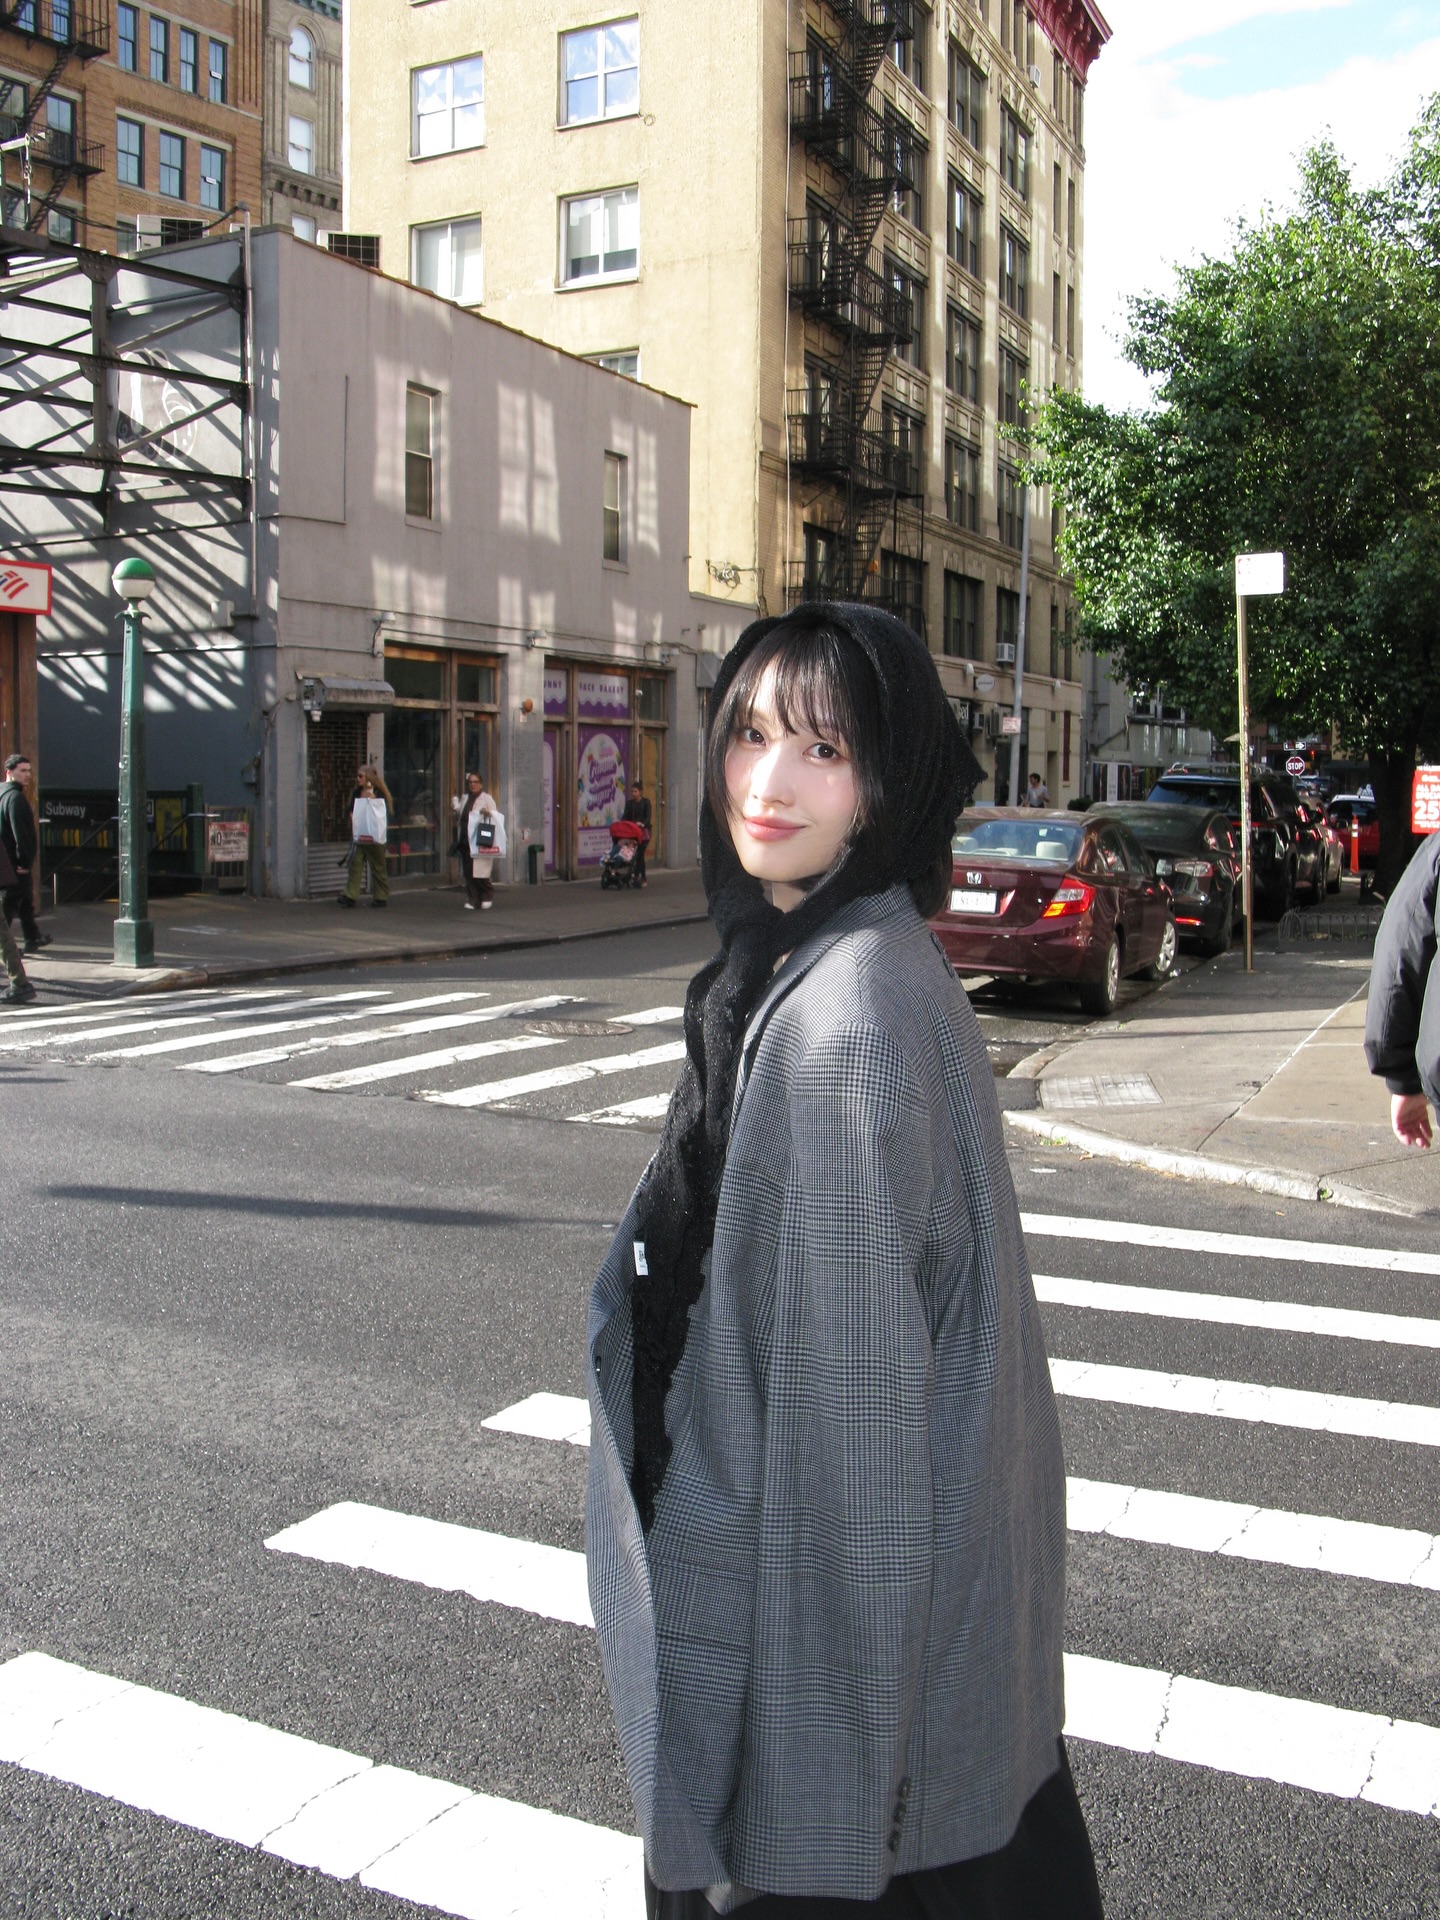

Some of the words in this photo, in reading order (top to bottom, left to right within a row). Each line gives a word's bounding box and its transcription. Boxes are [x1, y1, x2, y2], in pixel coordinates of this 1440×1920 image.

[579, 682, 595, 691] FACE
[599, 684, 624, 694] BAKERY
[1287, 762, 1304, 770] STOP
[46, 802, 86, 818] Subway
[1414, 800, 1440, 820] 25
